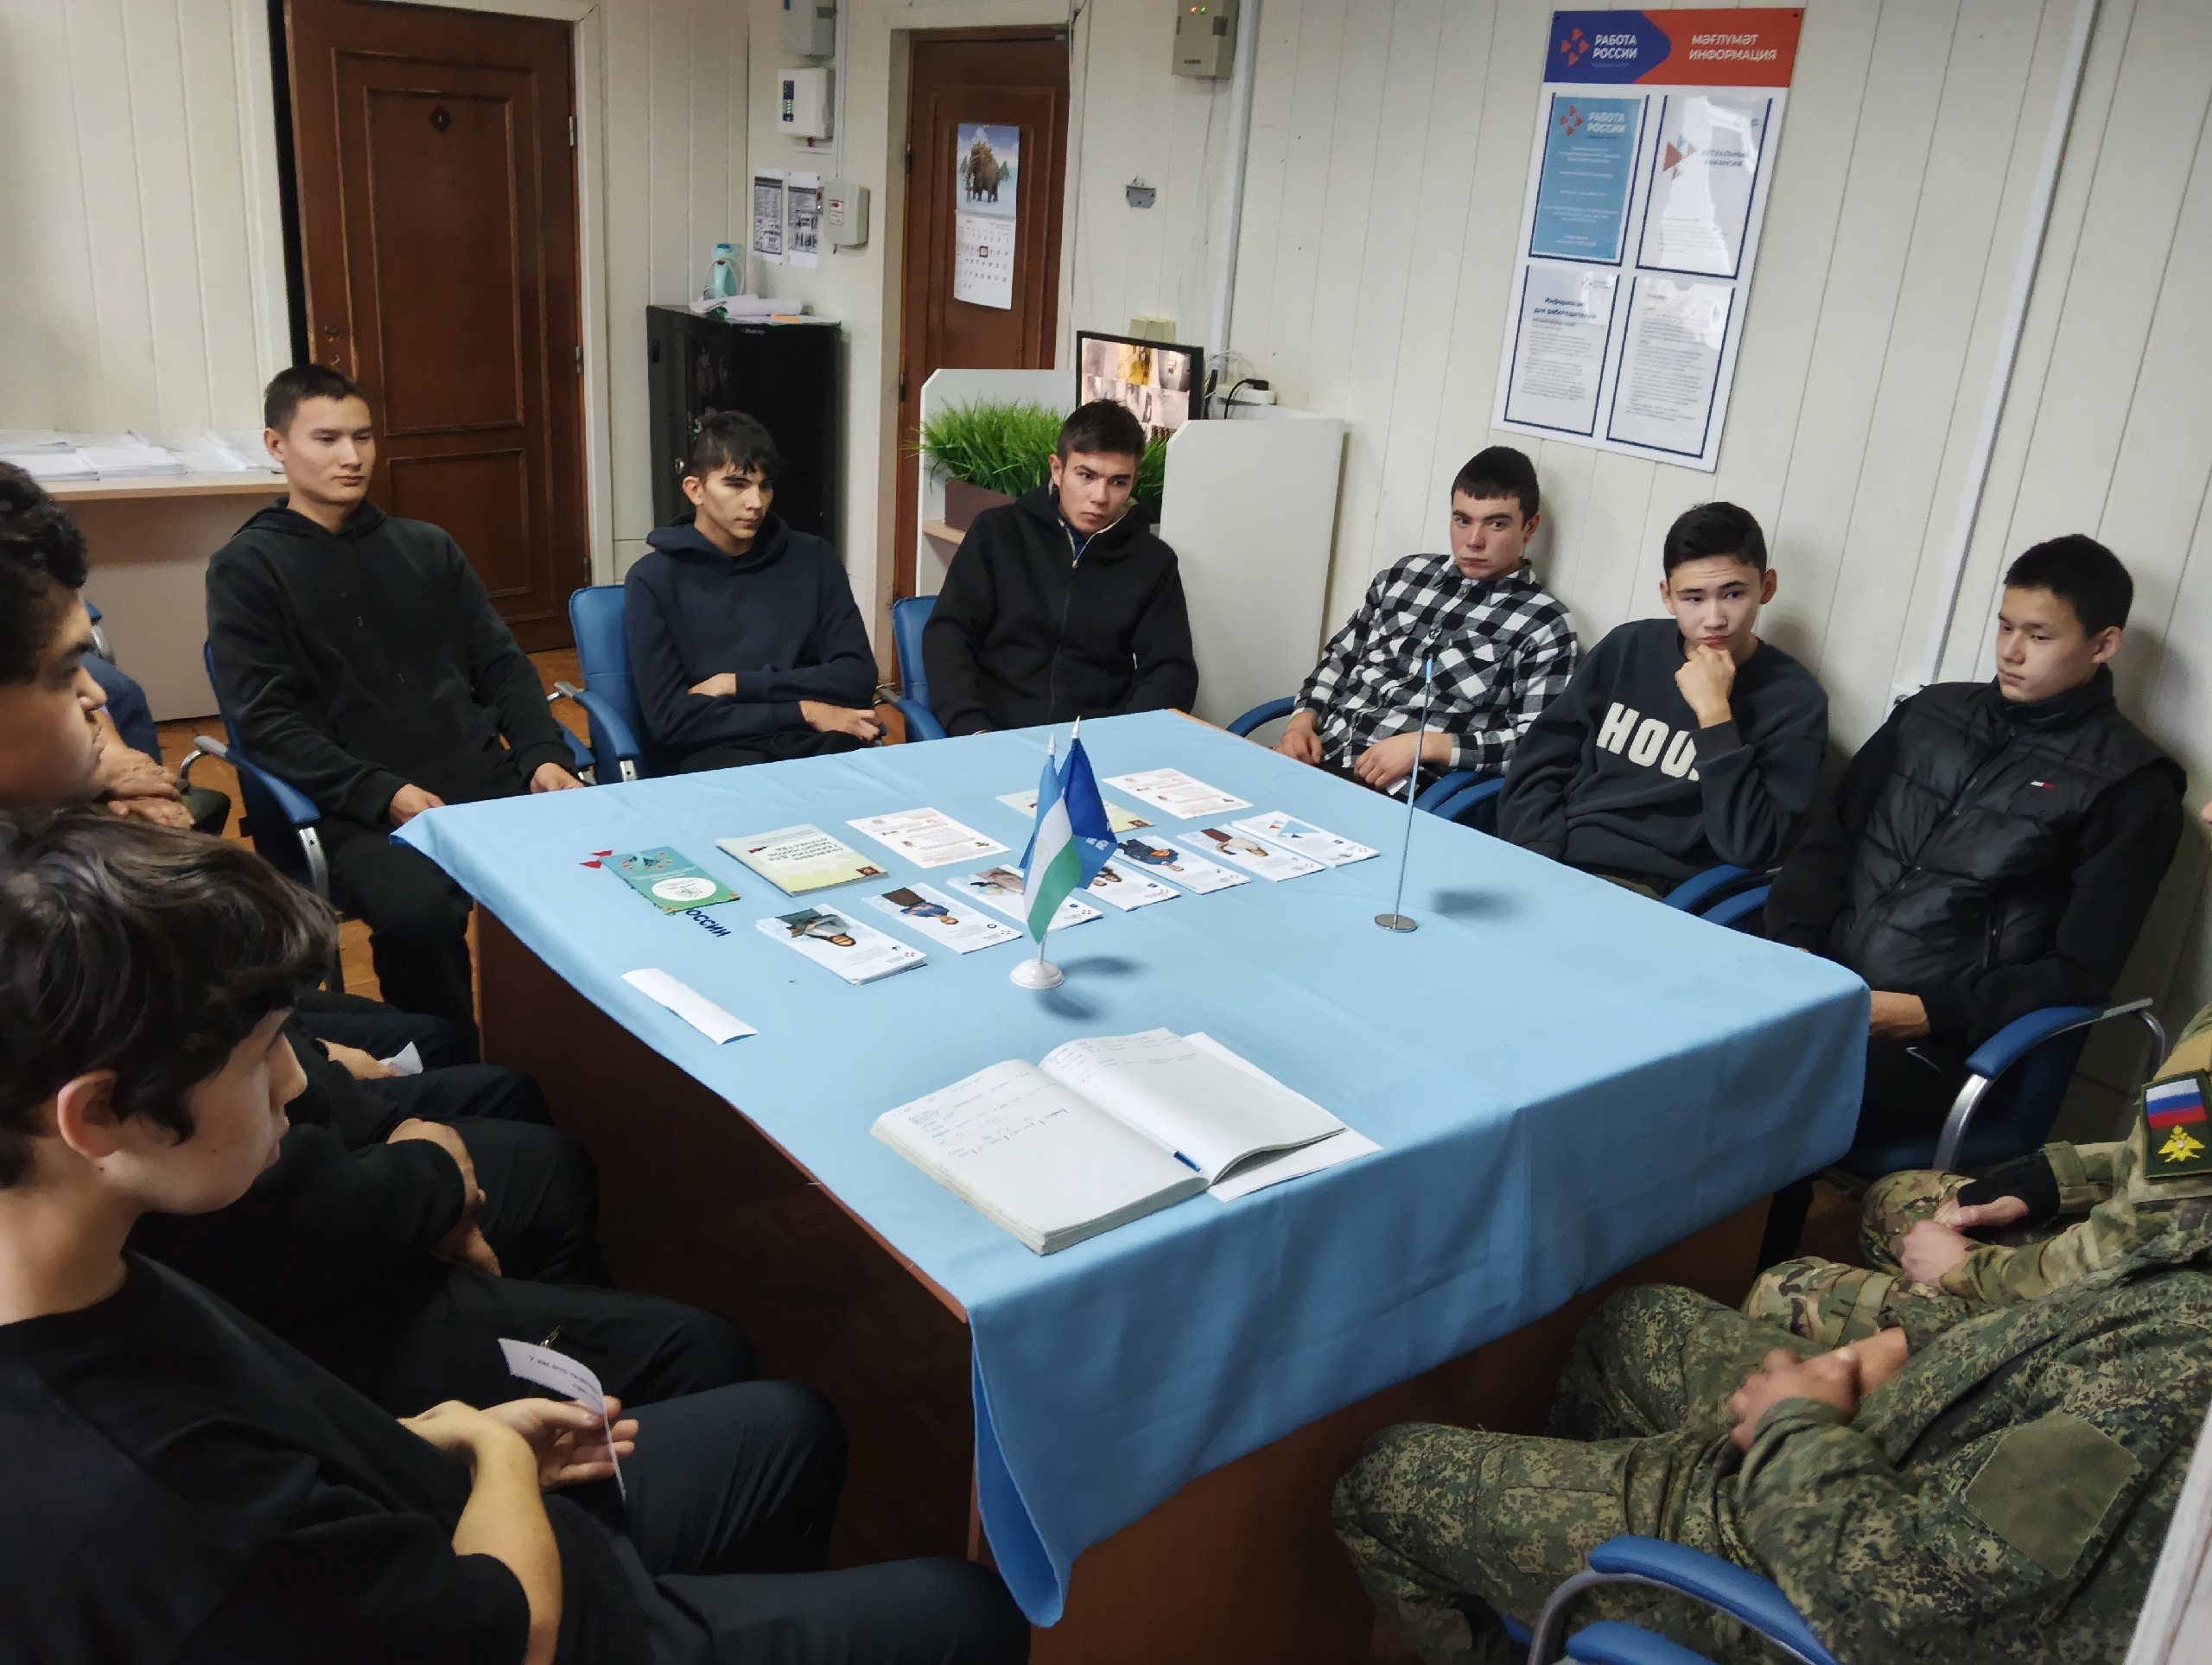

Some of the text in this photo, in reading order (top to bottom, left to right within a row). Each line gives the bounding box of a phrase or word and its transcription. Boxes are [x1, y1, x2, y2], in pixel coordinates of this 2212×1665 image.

[1594, 34, 1637, 46] РАБОТА
[1592, 48, 1638, 60] РОССИИ
[1689, 48, 1777, 61] ИНФОРМАЦИЯ
[1588, 111, 1624, 123] РАБОТА
[1586, 123, 1626, 133] РОССИИ
[1596, 702, 1700, 781] HOU
[685, 909, 731, 937] ОССИИ
